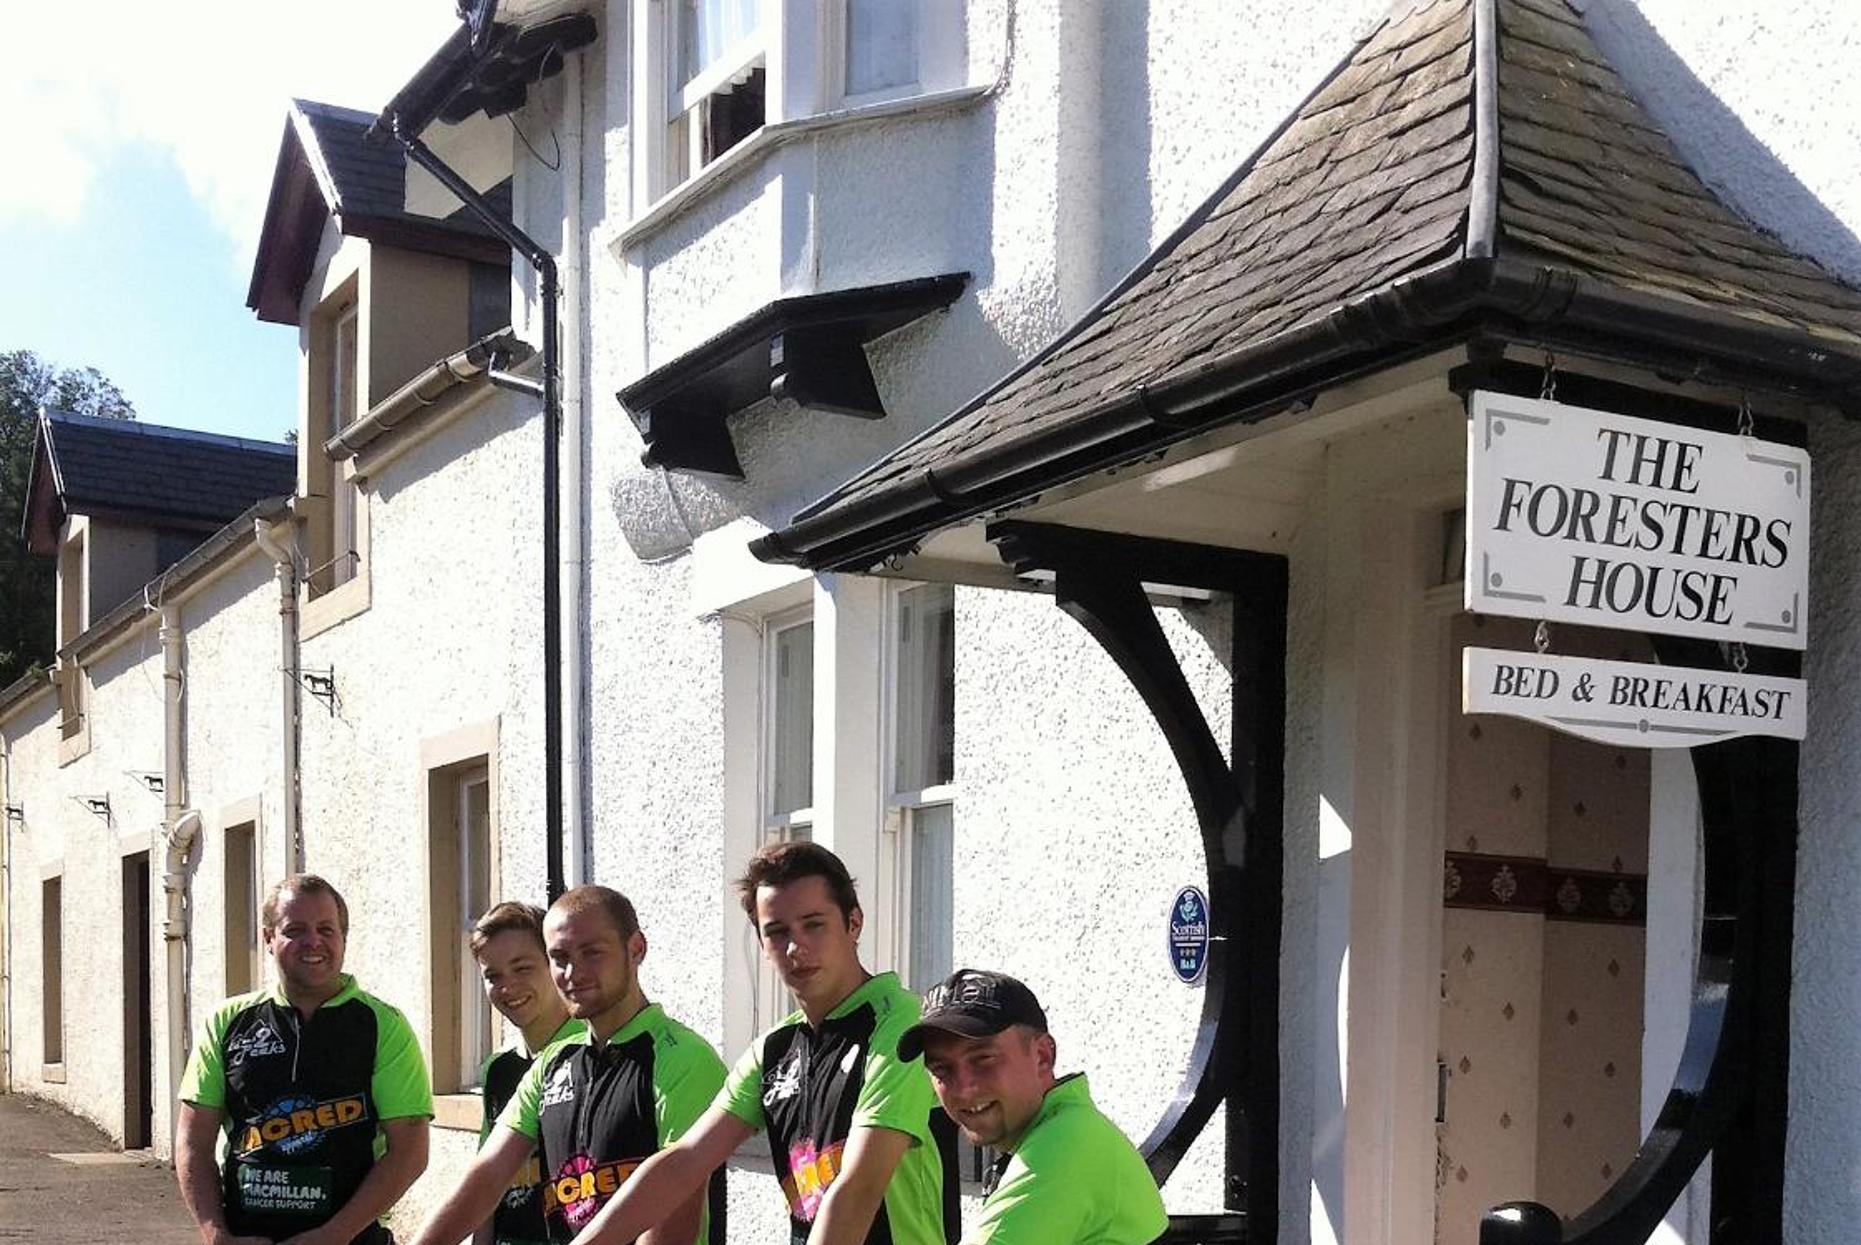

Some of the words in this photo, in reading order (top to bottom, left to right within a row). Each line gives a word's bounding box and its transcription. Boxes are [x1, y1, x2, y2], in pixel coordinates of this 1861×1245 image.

[1597, 427, 1704, 495] THE
[1492, 477, 1793, 569] FORESTERS
[1564, 555, 1739, 626] HOUSE
[1491, 664, 1560, 699] BED
[1571, 672, 1596, 703] &
[1608, 675, 1791, 720] BREAKFAST
[264, 1169, 289, 1185] ARE
[276, 1199, 317, 1210] SUPPORT
